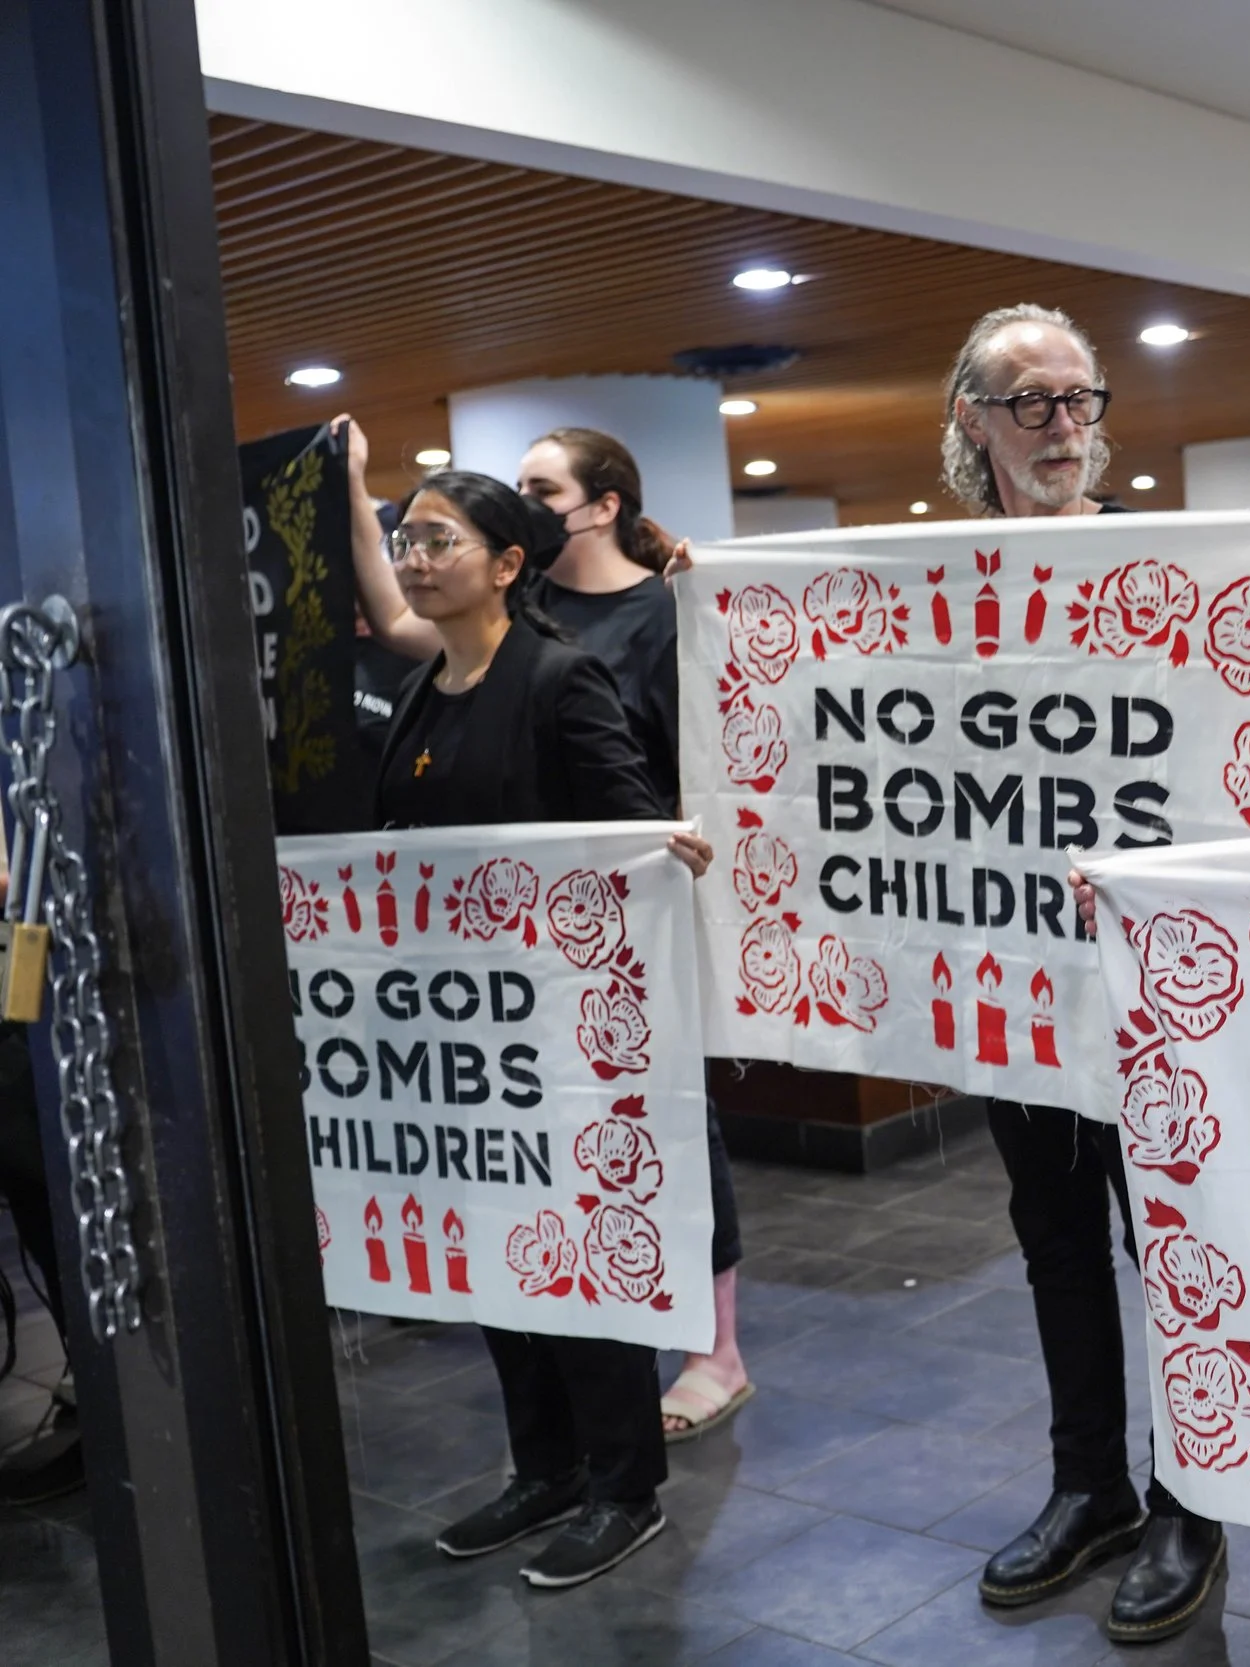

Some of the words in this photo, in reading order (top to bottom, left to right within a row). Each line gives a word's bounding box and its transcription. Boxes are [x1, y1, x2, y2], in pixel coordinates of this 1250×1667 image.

[815, 687, 935, 745] NO
[960, 690, 1174, 759] GOD
[816, 764, 1174, 850] BOMBS
[819, 854, 1097, 943] CHILDR
[375, 968, 536, 1022] GOD
[309, 1114, 553, 1188] HILDREN
